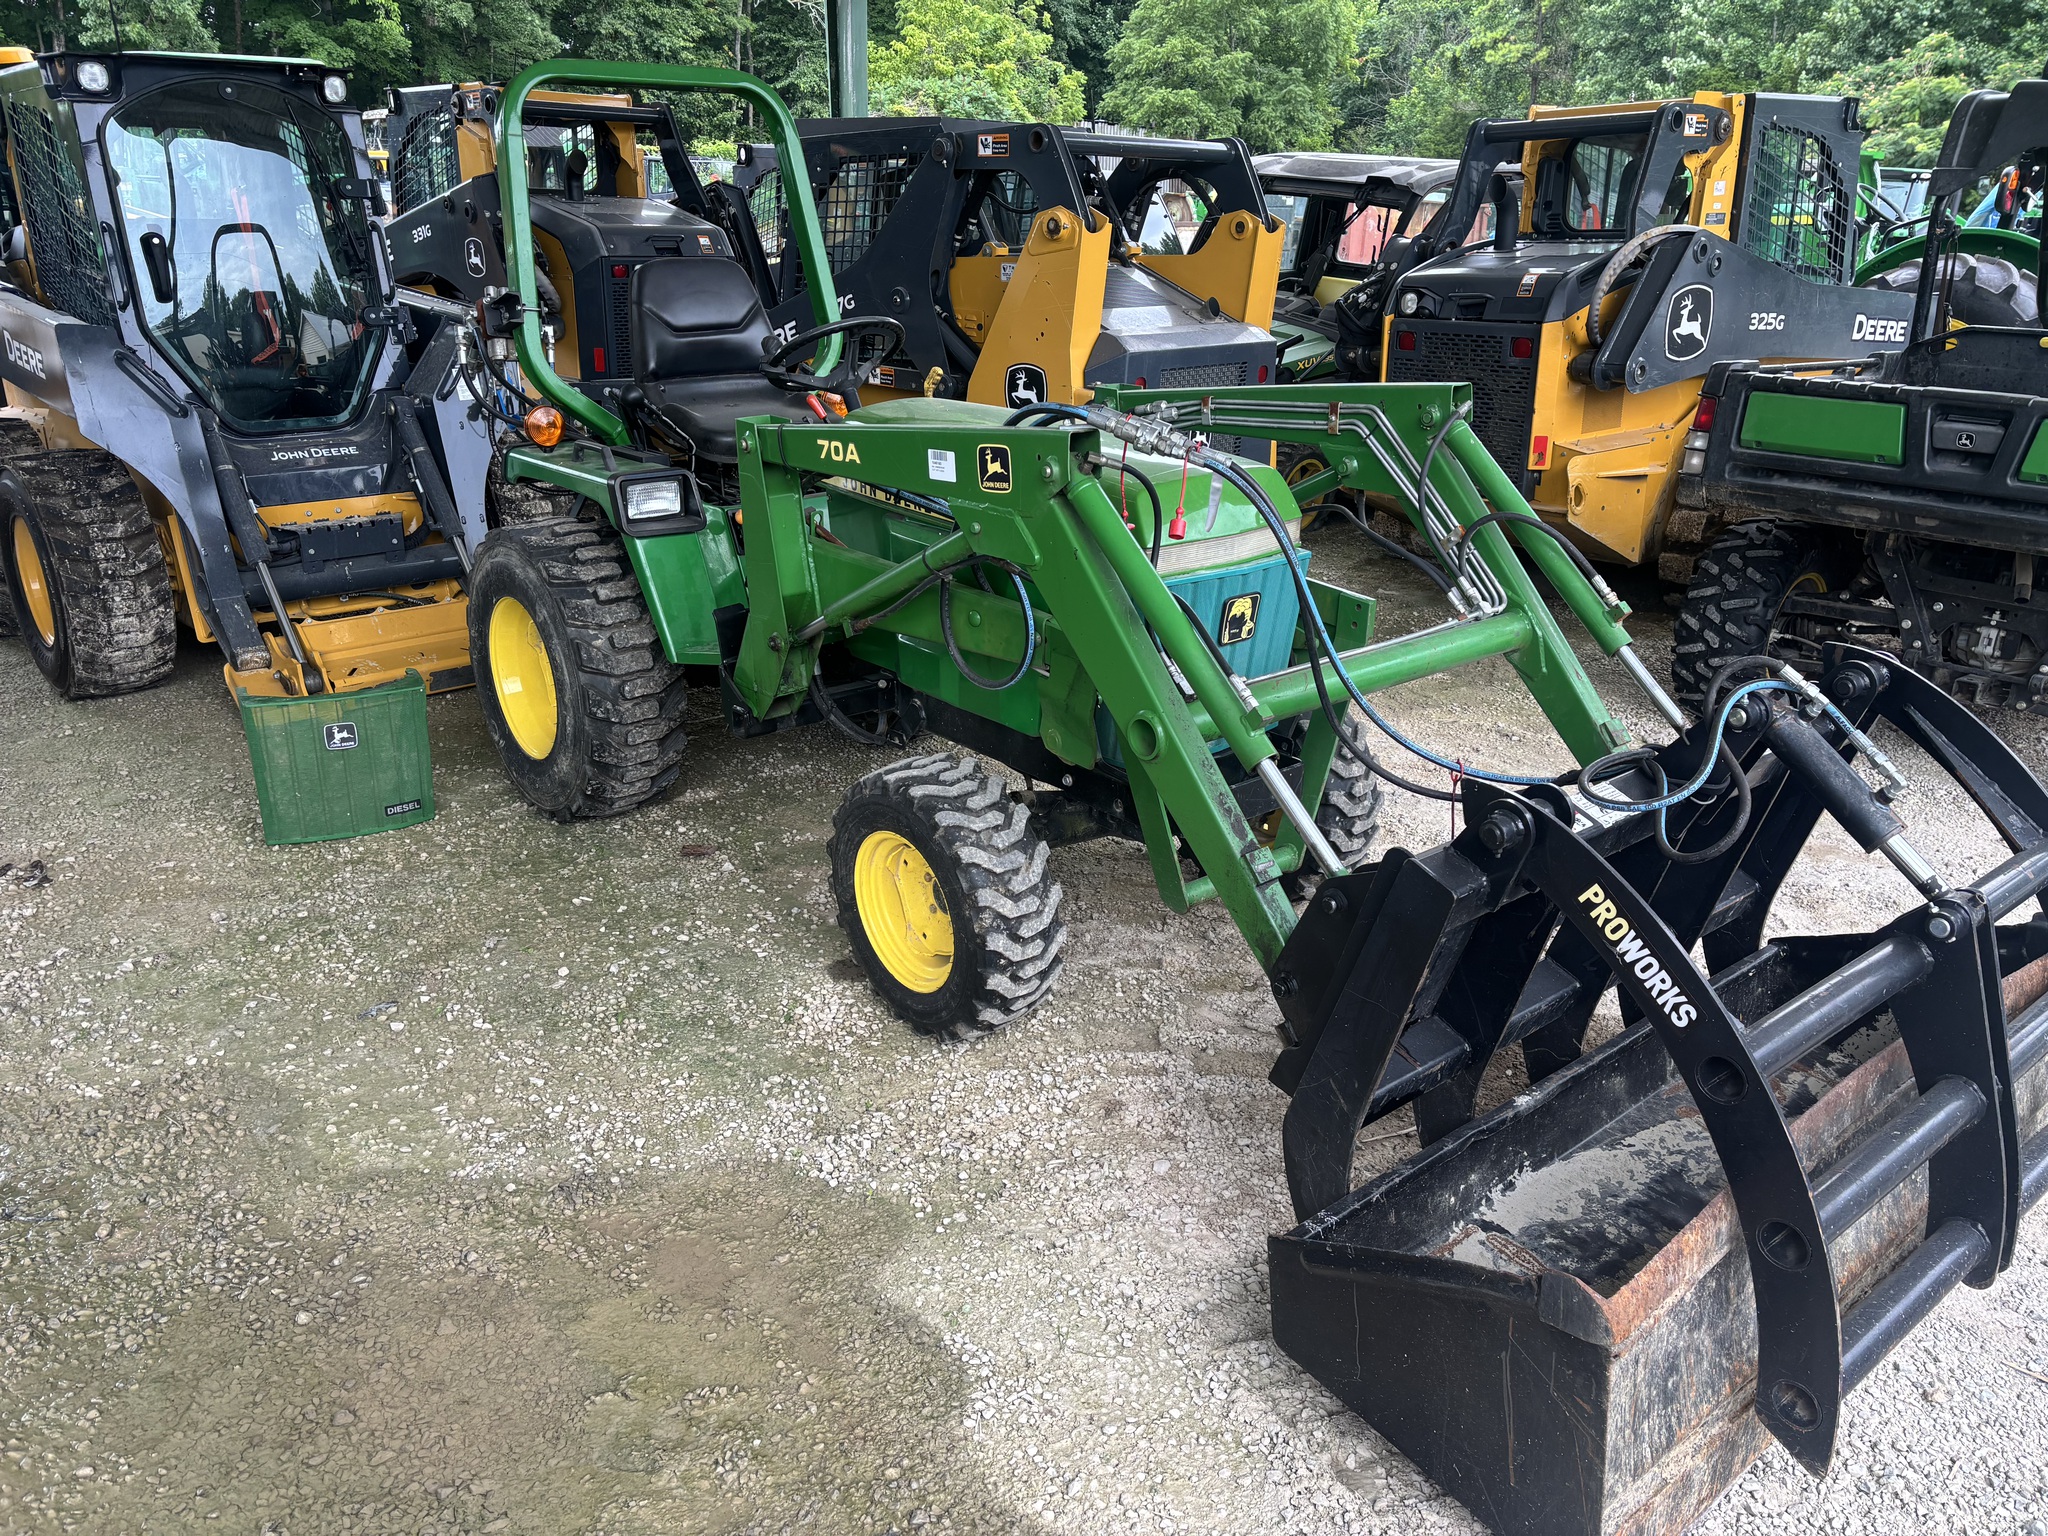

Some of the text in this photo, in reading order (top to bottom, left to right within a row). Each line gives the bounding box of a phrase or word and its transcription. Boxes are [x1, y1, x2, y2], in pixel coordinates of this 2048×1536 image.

[411, 224, 432, 243] 331G
[1748, 312, 1786, 331] 325G
[1851, 313, 1908, 343] DEERE
[3, 329, 47, 380] DEERE
[270, 446, 360, 461] JOHN DEERE
[816, 438, 862, 465] 70A
[842, 477, 877, 498] JOHN
[386, 801, 421, 815] DIESEL
[1577, 882, 1698, 1028] PROWORKS
